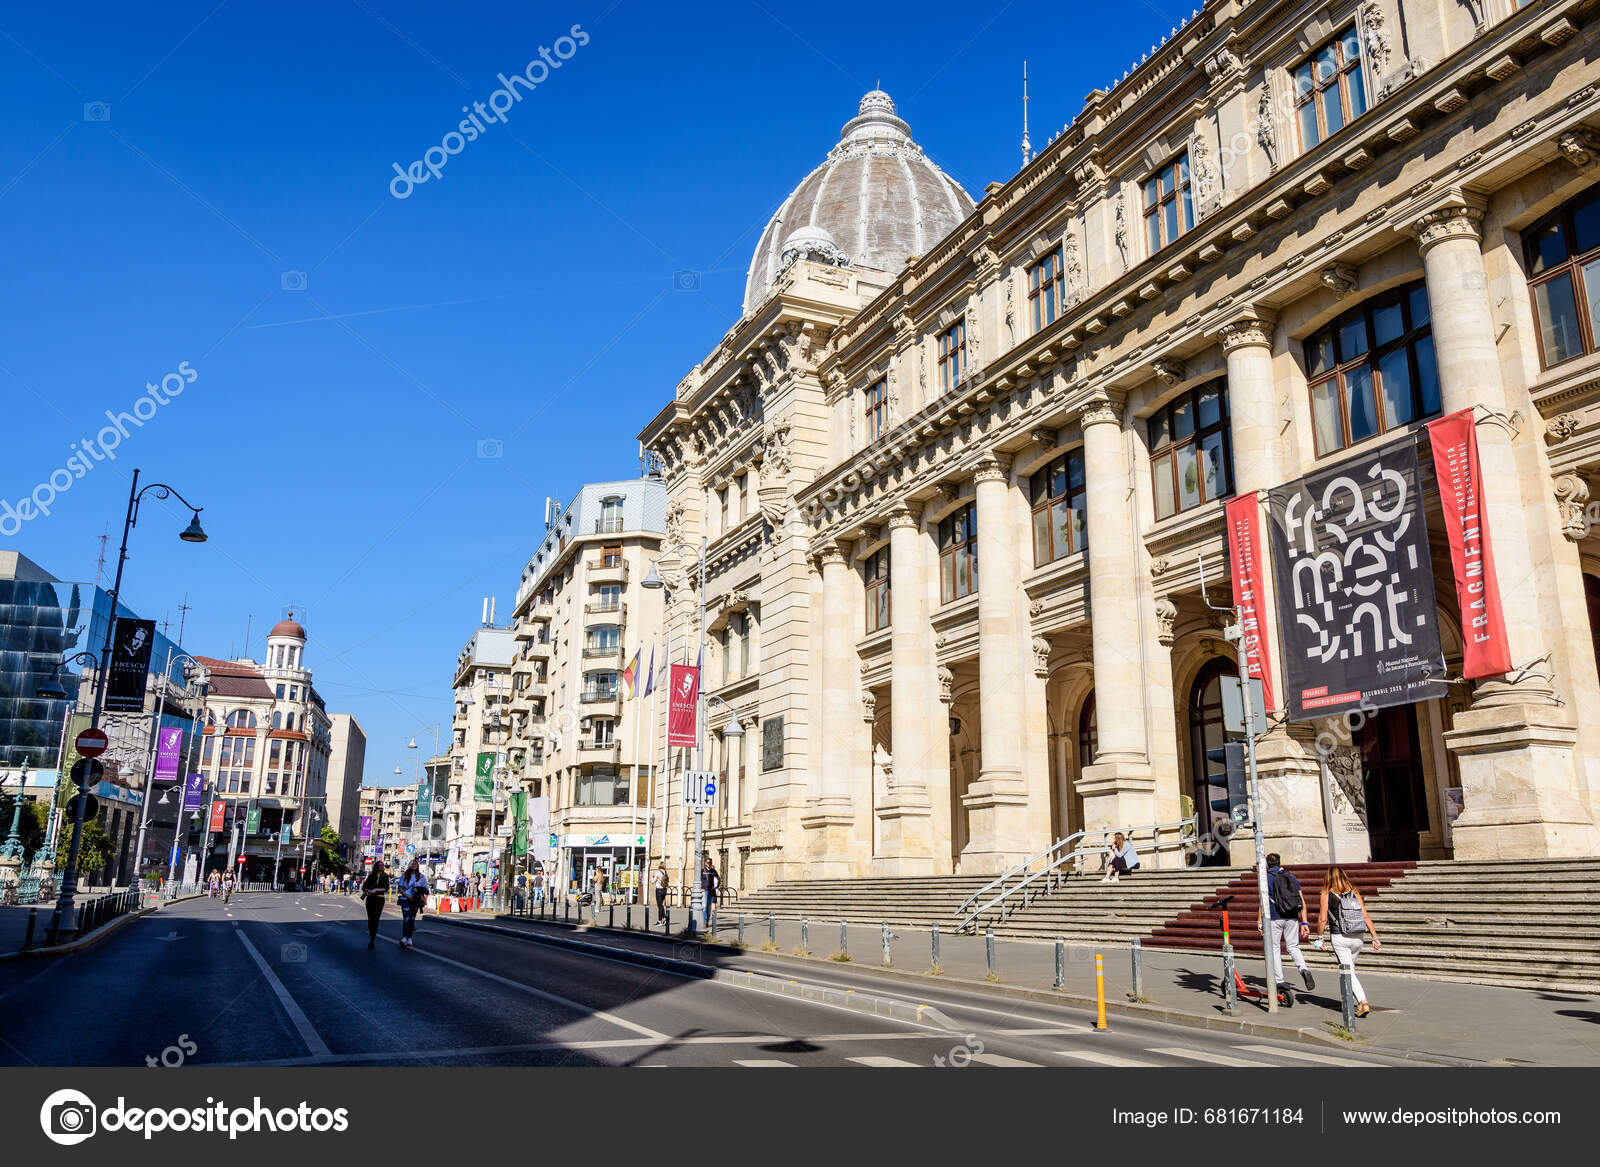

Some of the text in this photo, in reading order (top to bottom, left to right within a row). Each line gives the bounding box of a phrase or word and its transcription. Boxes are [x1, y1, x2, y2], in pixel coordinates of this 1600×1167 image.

[1240, 577, 1262, 674] RAGMENT
[1461, 512, 1490, 644] FRAGMENT
[114, 661, 146, 669] ENESCU
